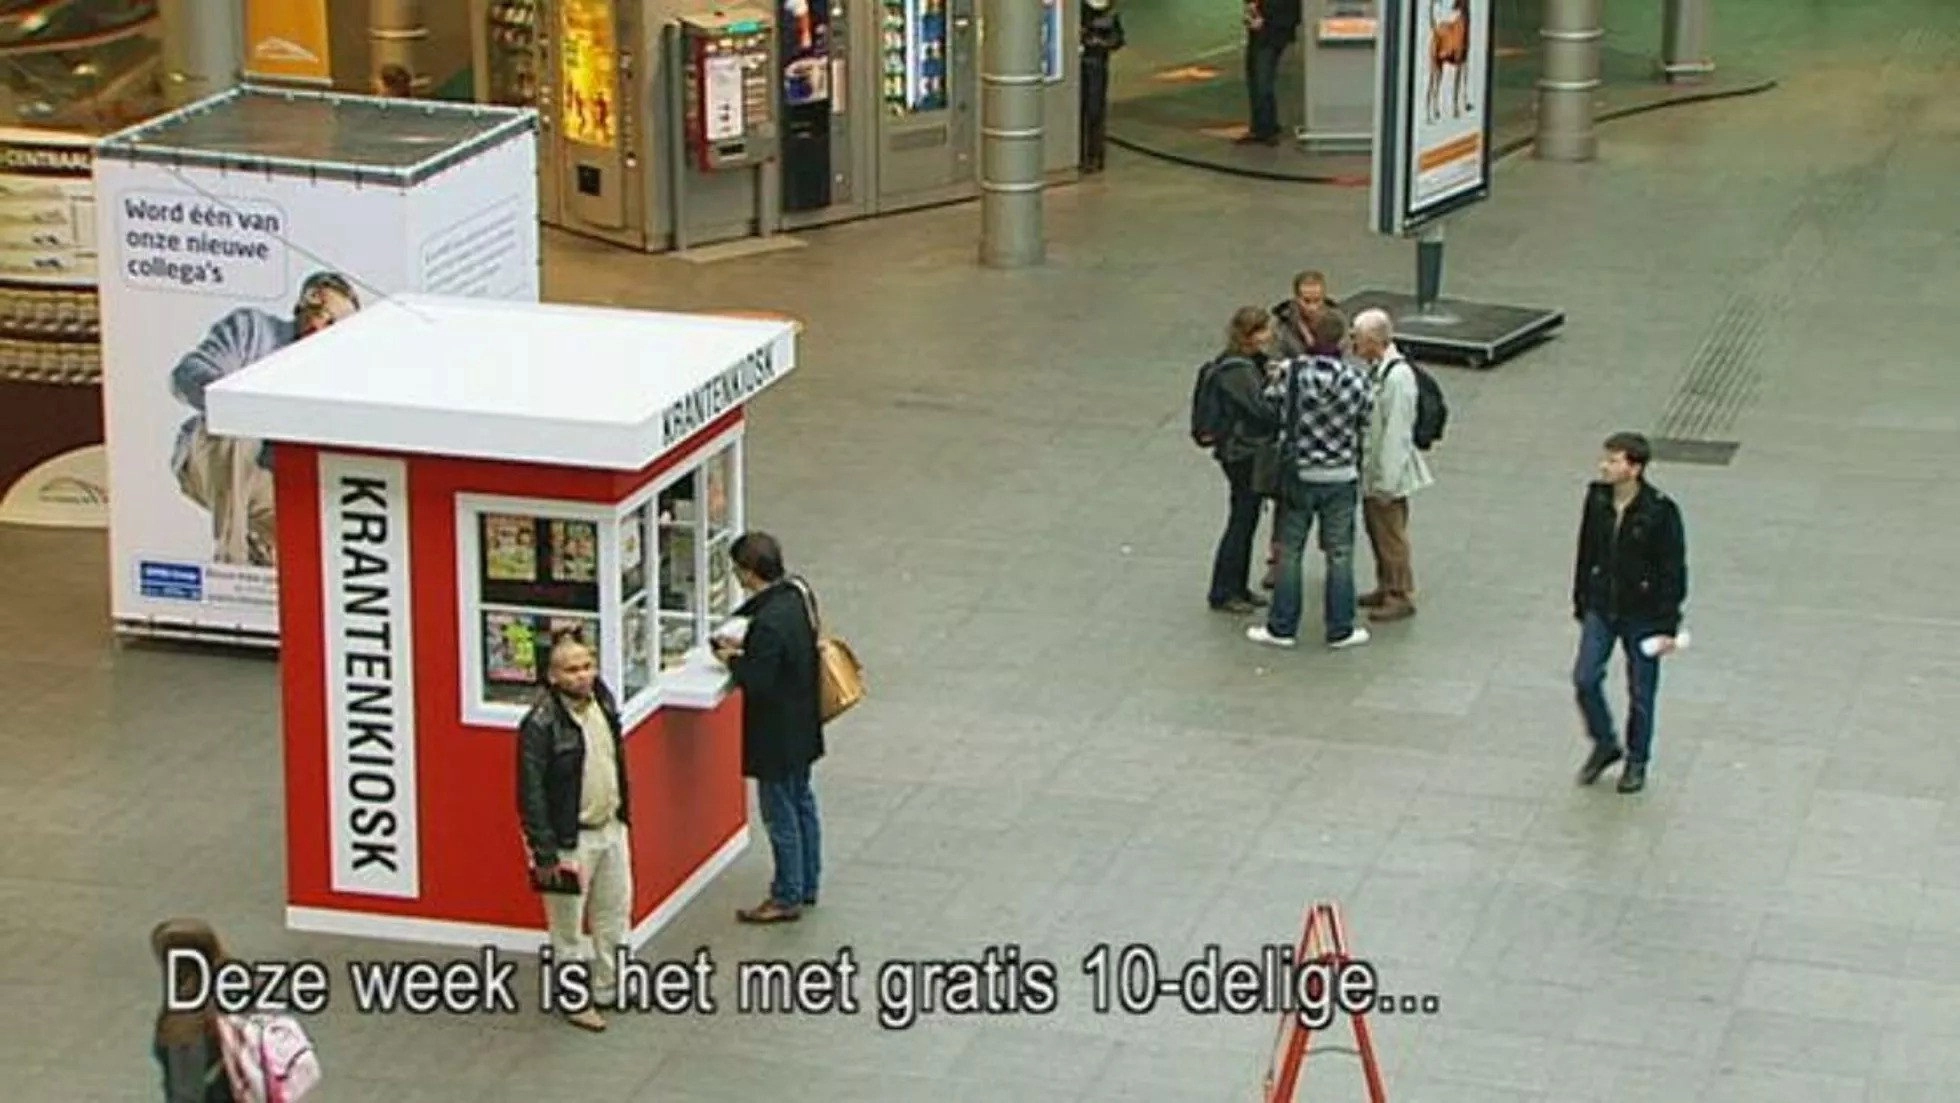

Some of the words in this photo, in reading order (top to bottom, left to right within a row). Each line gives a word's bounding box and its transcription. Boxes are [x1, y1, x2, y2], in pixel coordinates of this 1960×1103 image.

[125, 198, 185, 224] Word
[189, 205, 232, 229] één
[237, 211, 280, 233] van
[125, 230, 182, 252] onze
[187, 231, 270, 261] nieuwe
[126, 256, 225, 285] collega's
[662, 342, 776, 446] KRANTENKIOSK
[339, 476, 398, 873] KRANTENKIOSK
